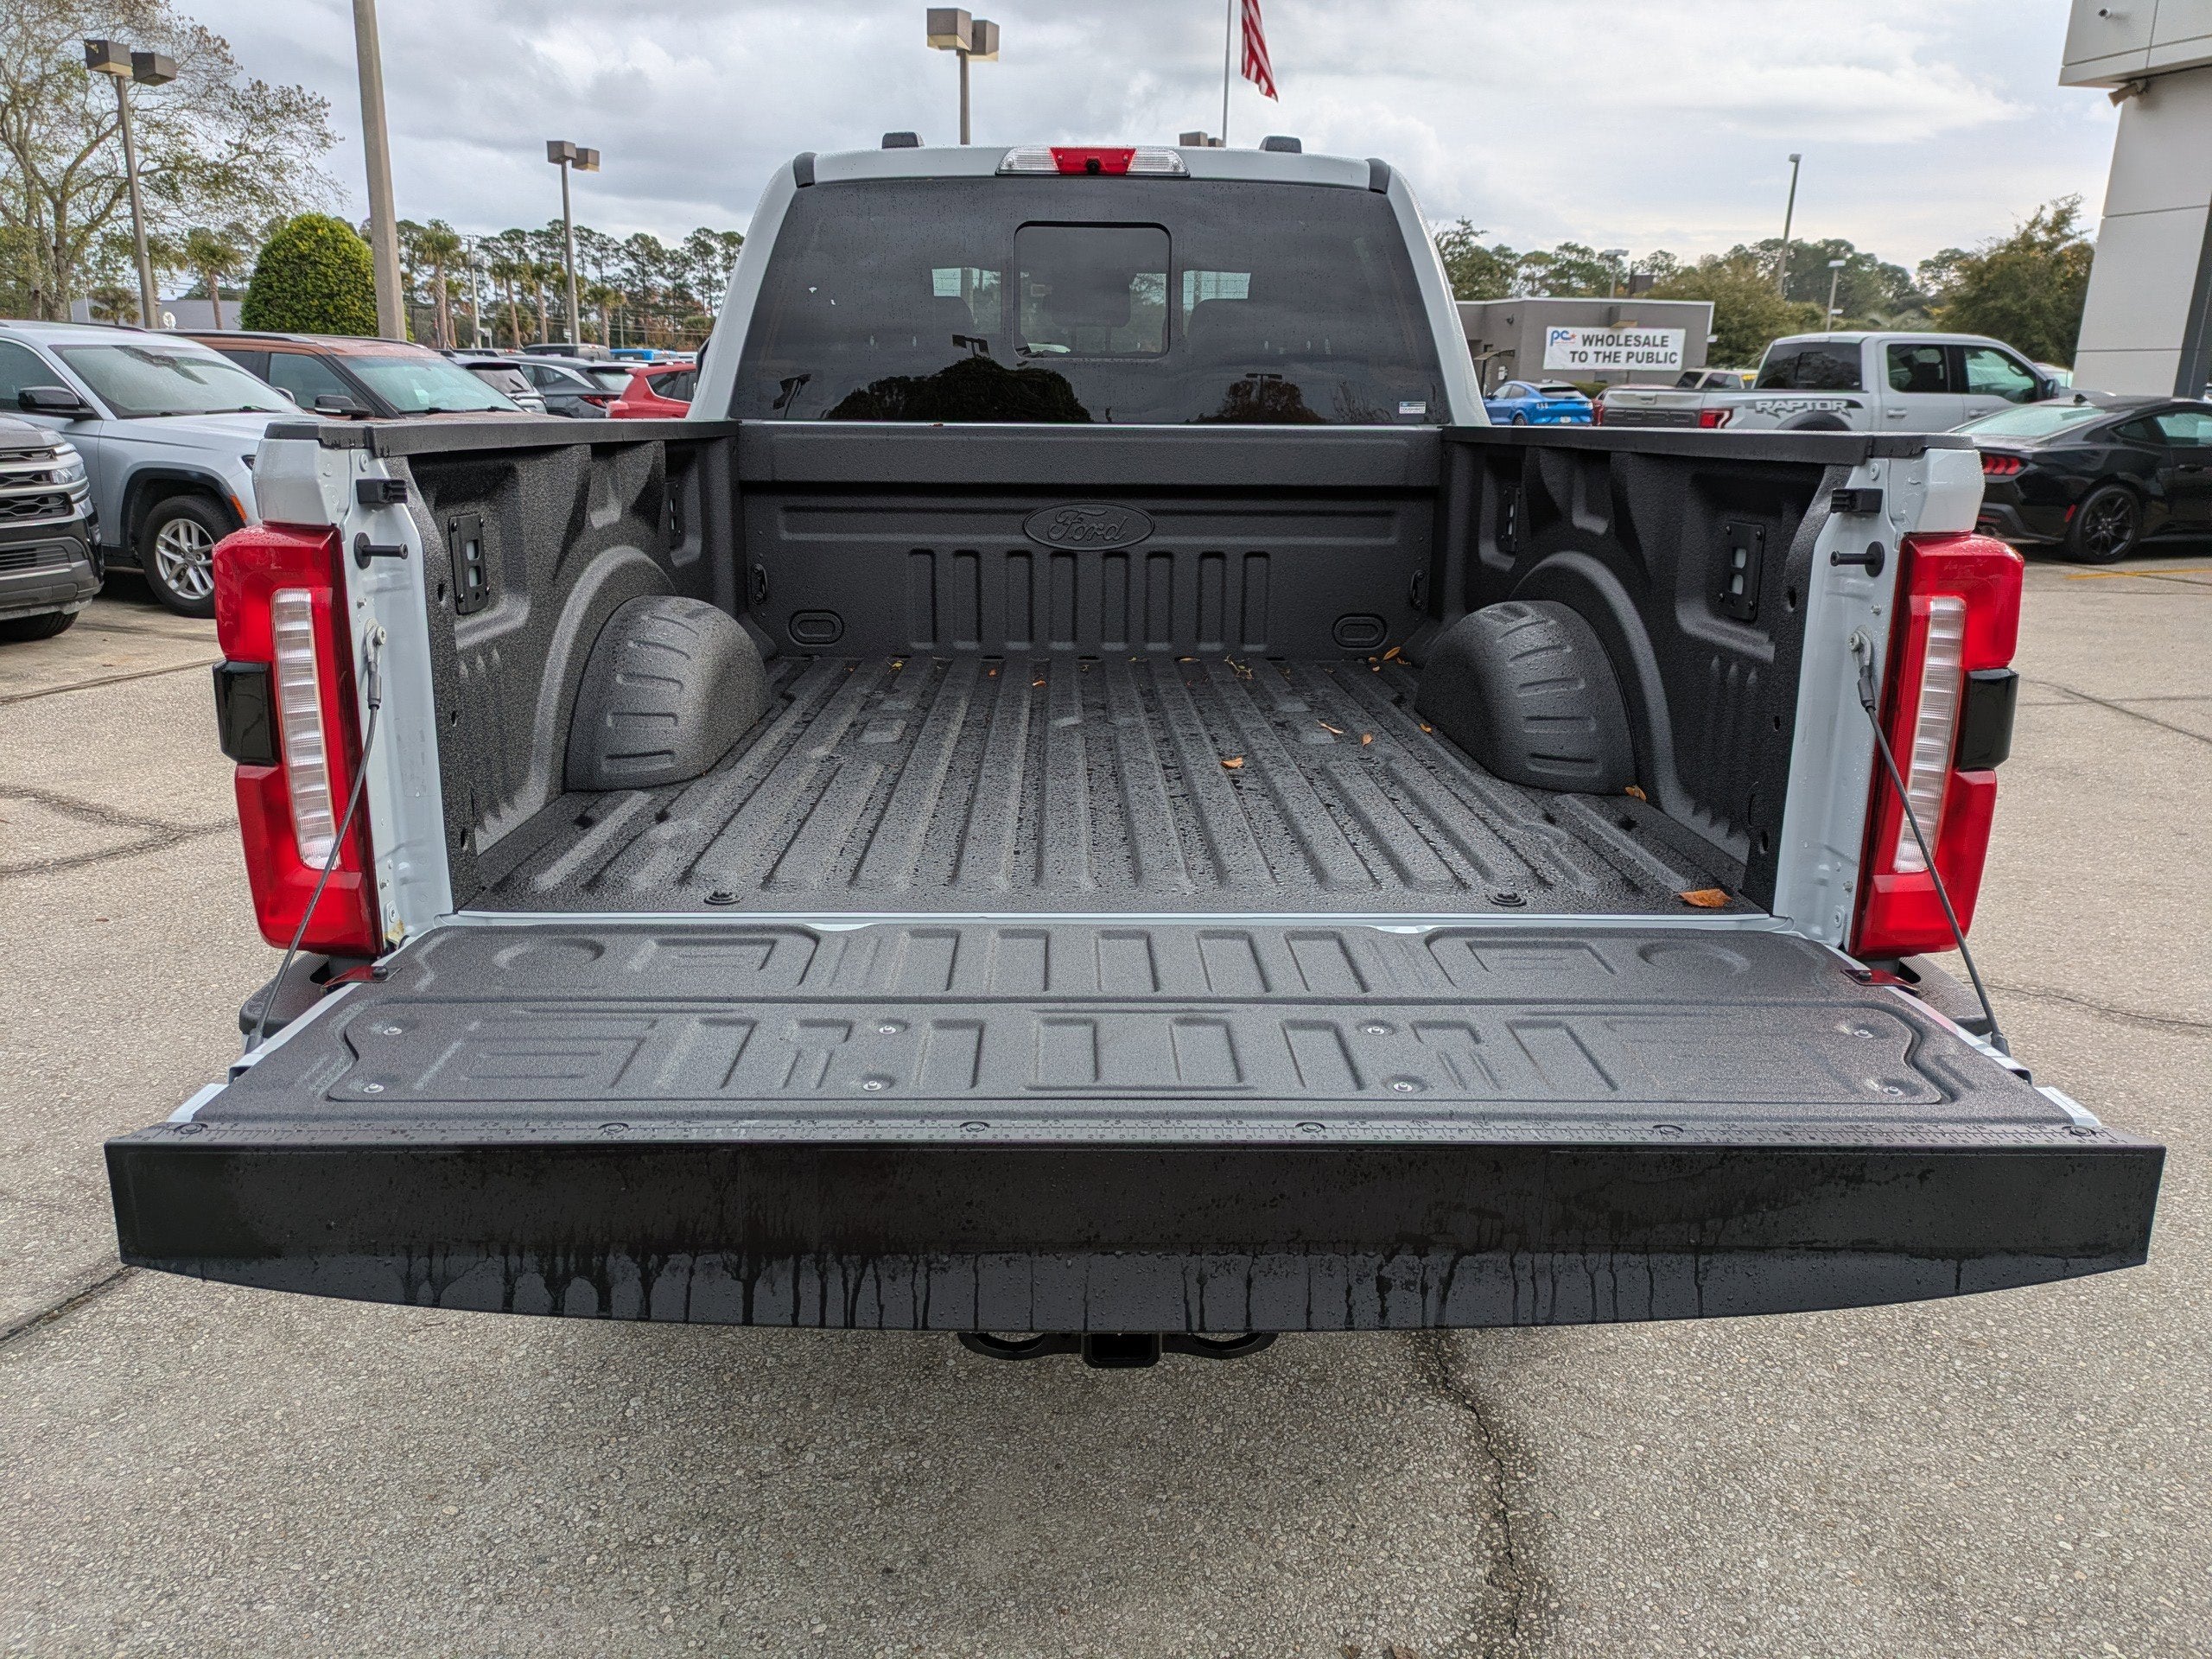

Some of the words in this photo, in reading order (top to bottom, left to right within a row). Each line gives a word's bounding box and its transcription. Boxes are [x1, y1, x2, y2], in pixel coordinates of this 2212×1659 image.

[1581, 334, 1669, 348] WHOLESALE
[1569, 350, 1588, 364] TO
[1593, 351, 1621, 364] THE
[1625, 351, 1678, 365] PUBLIC
[1755, 400, 1853, 418] RAPTOR
[1047, 509, 1128, 542] Ford
